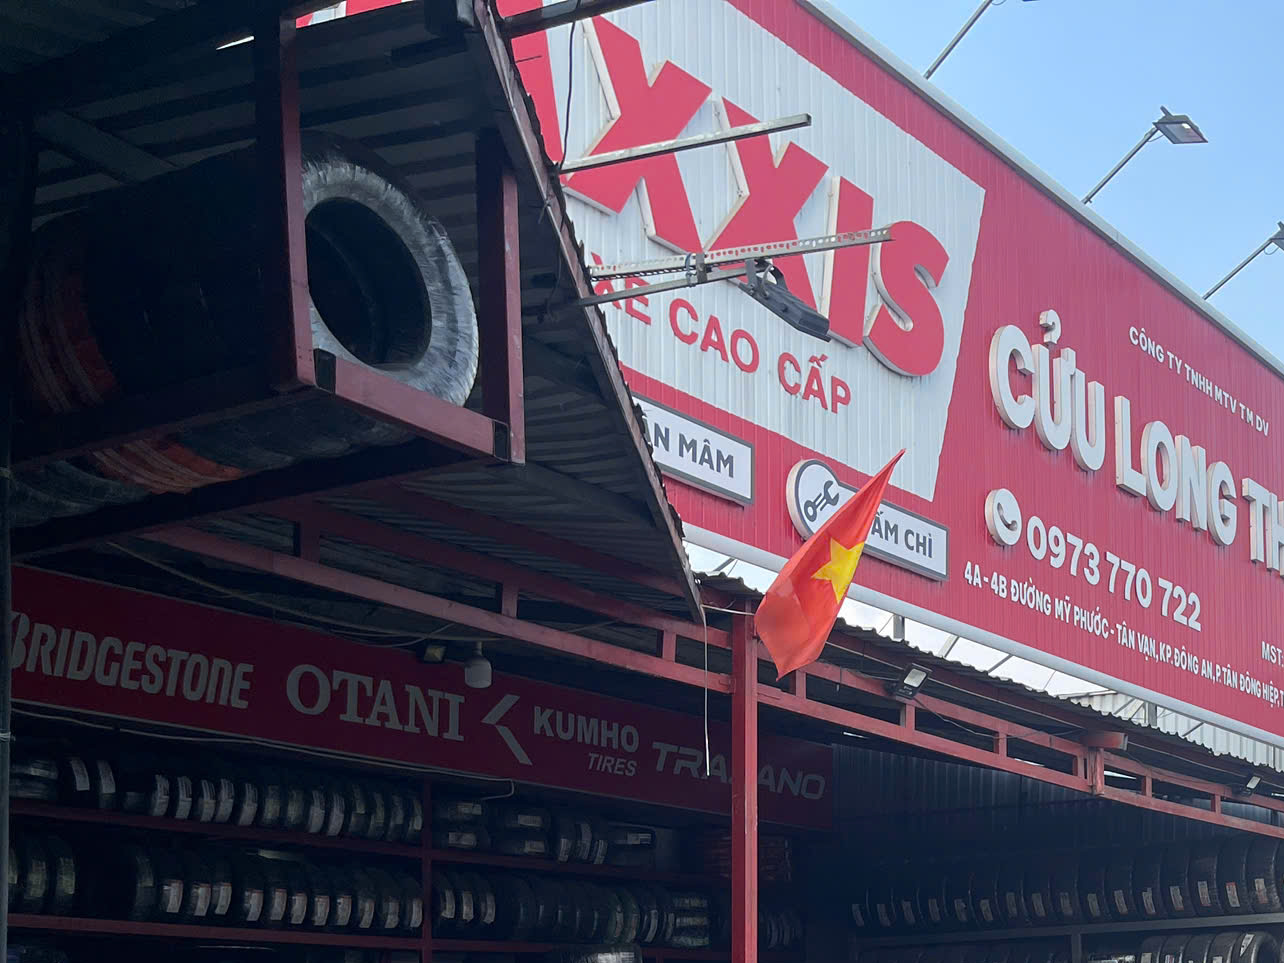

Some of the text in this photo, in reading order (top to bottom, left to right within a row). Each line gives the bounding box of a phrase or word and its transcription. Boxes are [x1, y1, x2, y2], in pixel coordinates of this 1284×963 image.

[504, 0, 950, 376] XXIS
[669, 298, 760, 374] CAO
[778, 353, 852, 415] CẤP
[1129, 326, 1165, 363] CÔNG
[1166, 350, 1183, 375] TY
[1184, 363, 1213, 398] TNHH
[1214, 384, 1237, 414] MTV
[1255, 414, 1269, 436] DV
[678, 432, 734, 479] MÂM
[989, 308, 1106, 471] CỬU
[1113, 396, 1238, 547] LONG
[964, 561, 983, 588] 4A
[990, 572, 1007, 598] 4B
[1010, 577, 1052, 616] ĐƯỜNG
[1054, 596, 1072, 623] MỸ
[1073, 606, 1109, 639] PHƯỚC
[1116, 621, 1136, 650] TÂN
[1027, 516, 1202, 633] 0973 770 722
[10, 609, 254, 710] BRIDGESTONE
[286, 663, 465, 742] OTANI
[533, 705, 640, 753] KUMHO
[587, 752, 638, 778] TIRES
[652, 741, 827, 800] TRAANO
